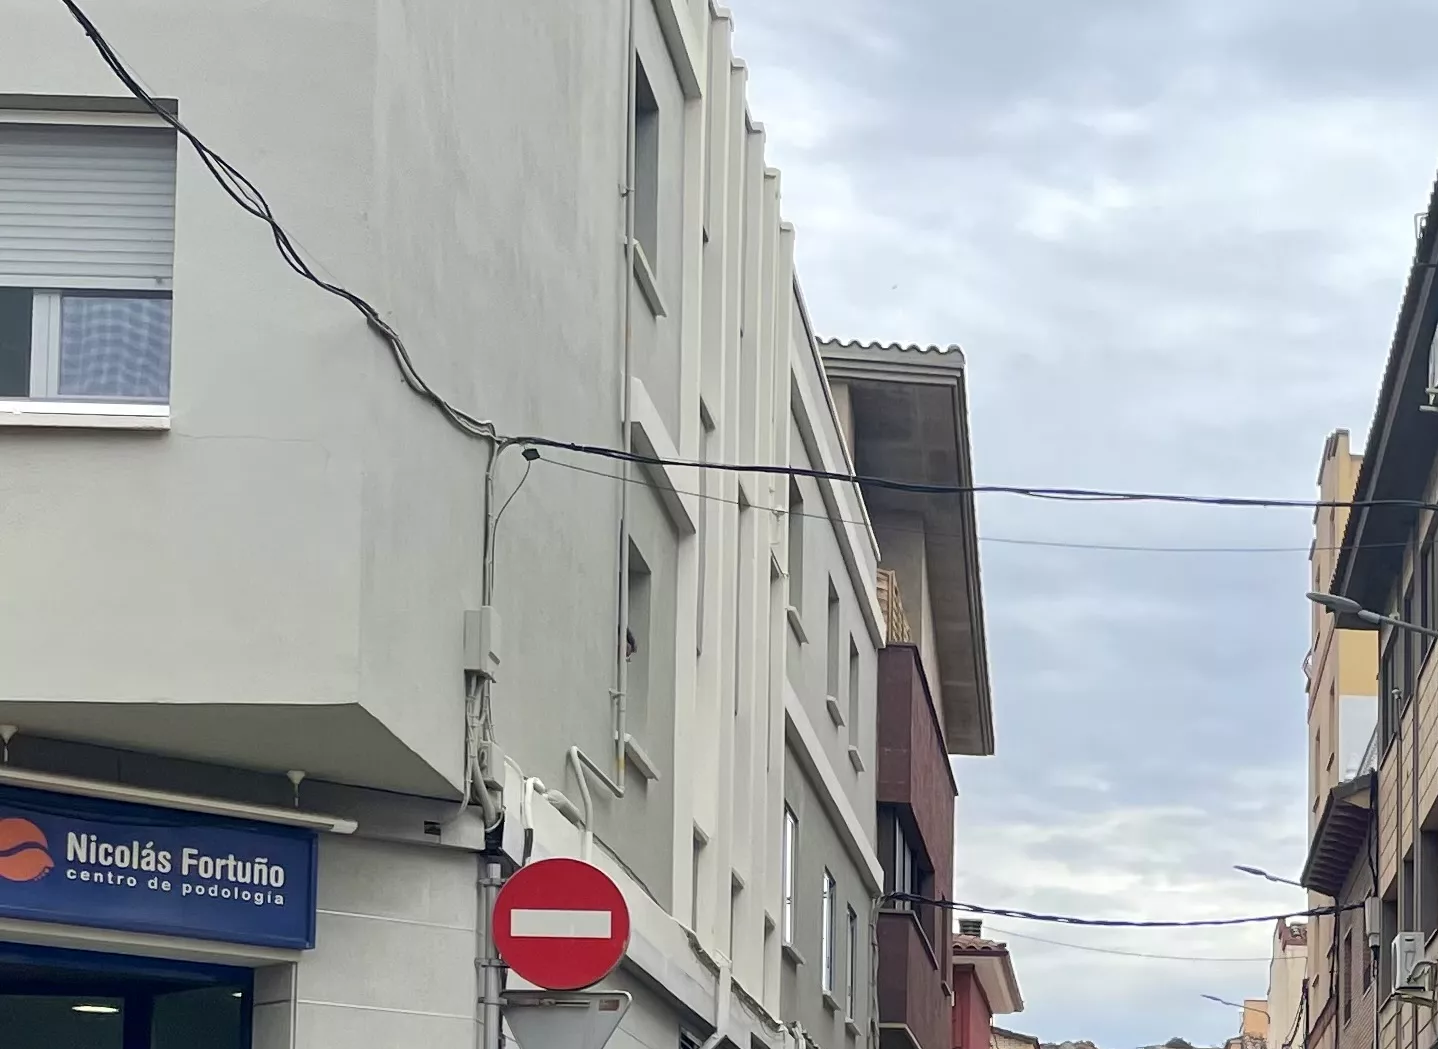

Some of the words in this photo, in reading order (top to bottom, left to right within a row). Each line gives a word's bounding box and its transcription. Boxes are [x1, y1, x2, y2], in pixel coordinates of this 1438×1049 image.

[67, 831, 172, 874] Nicolás
[182, 848, 285, 888] Fortuño
[66, 867, 138, 888] centro
[148, 876, 172, 892] de
[182, 883, 285, 906] podología
